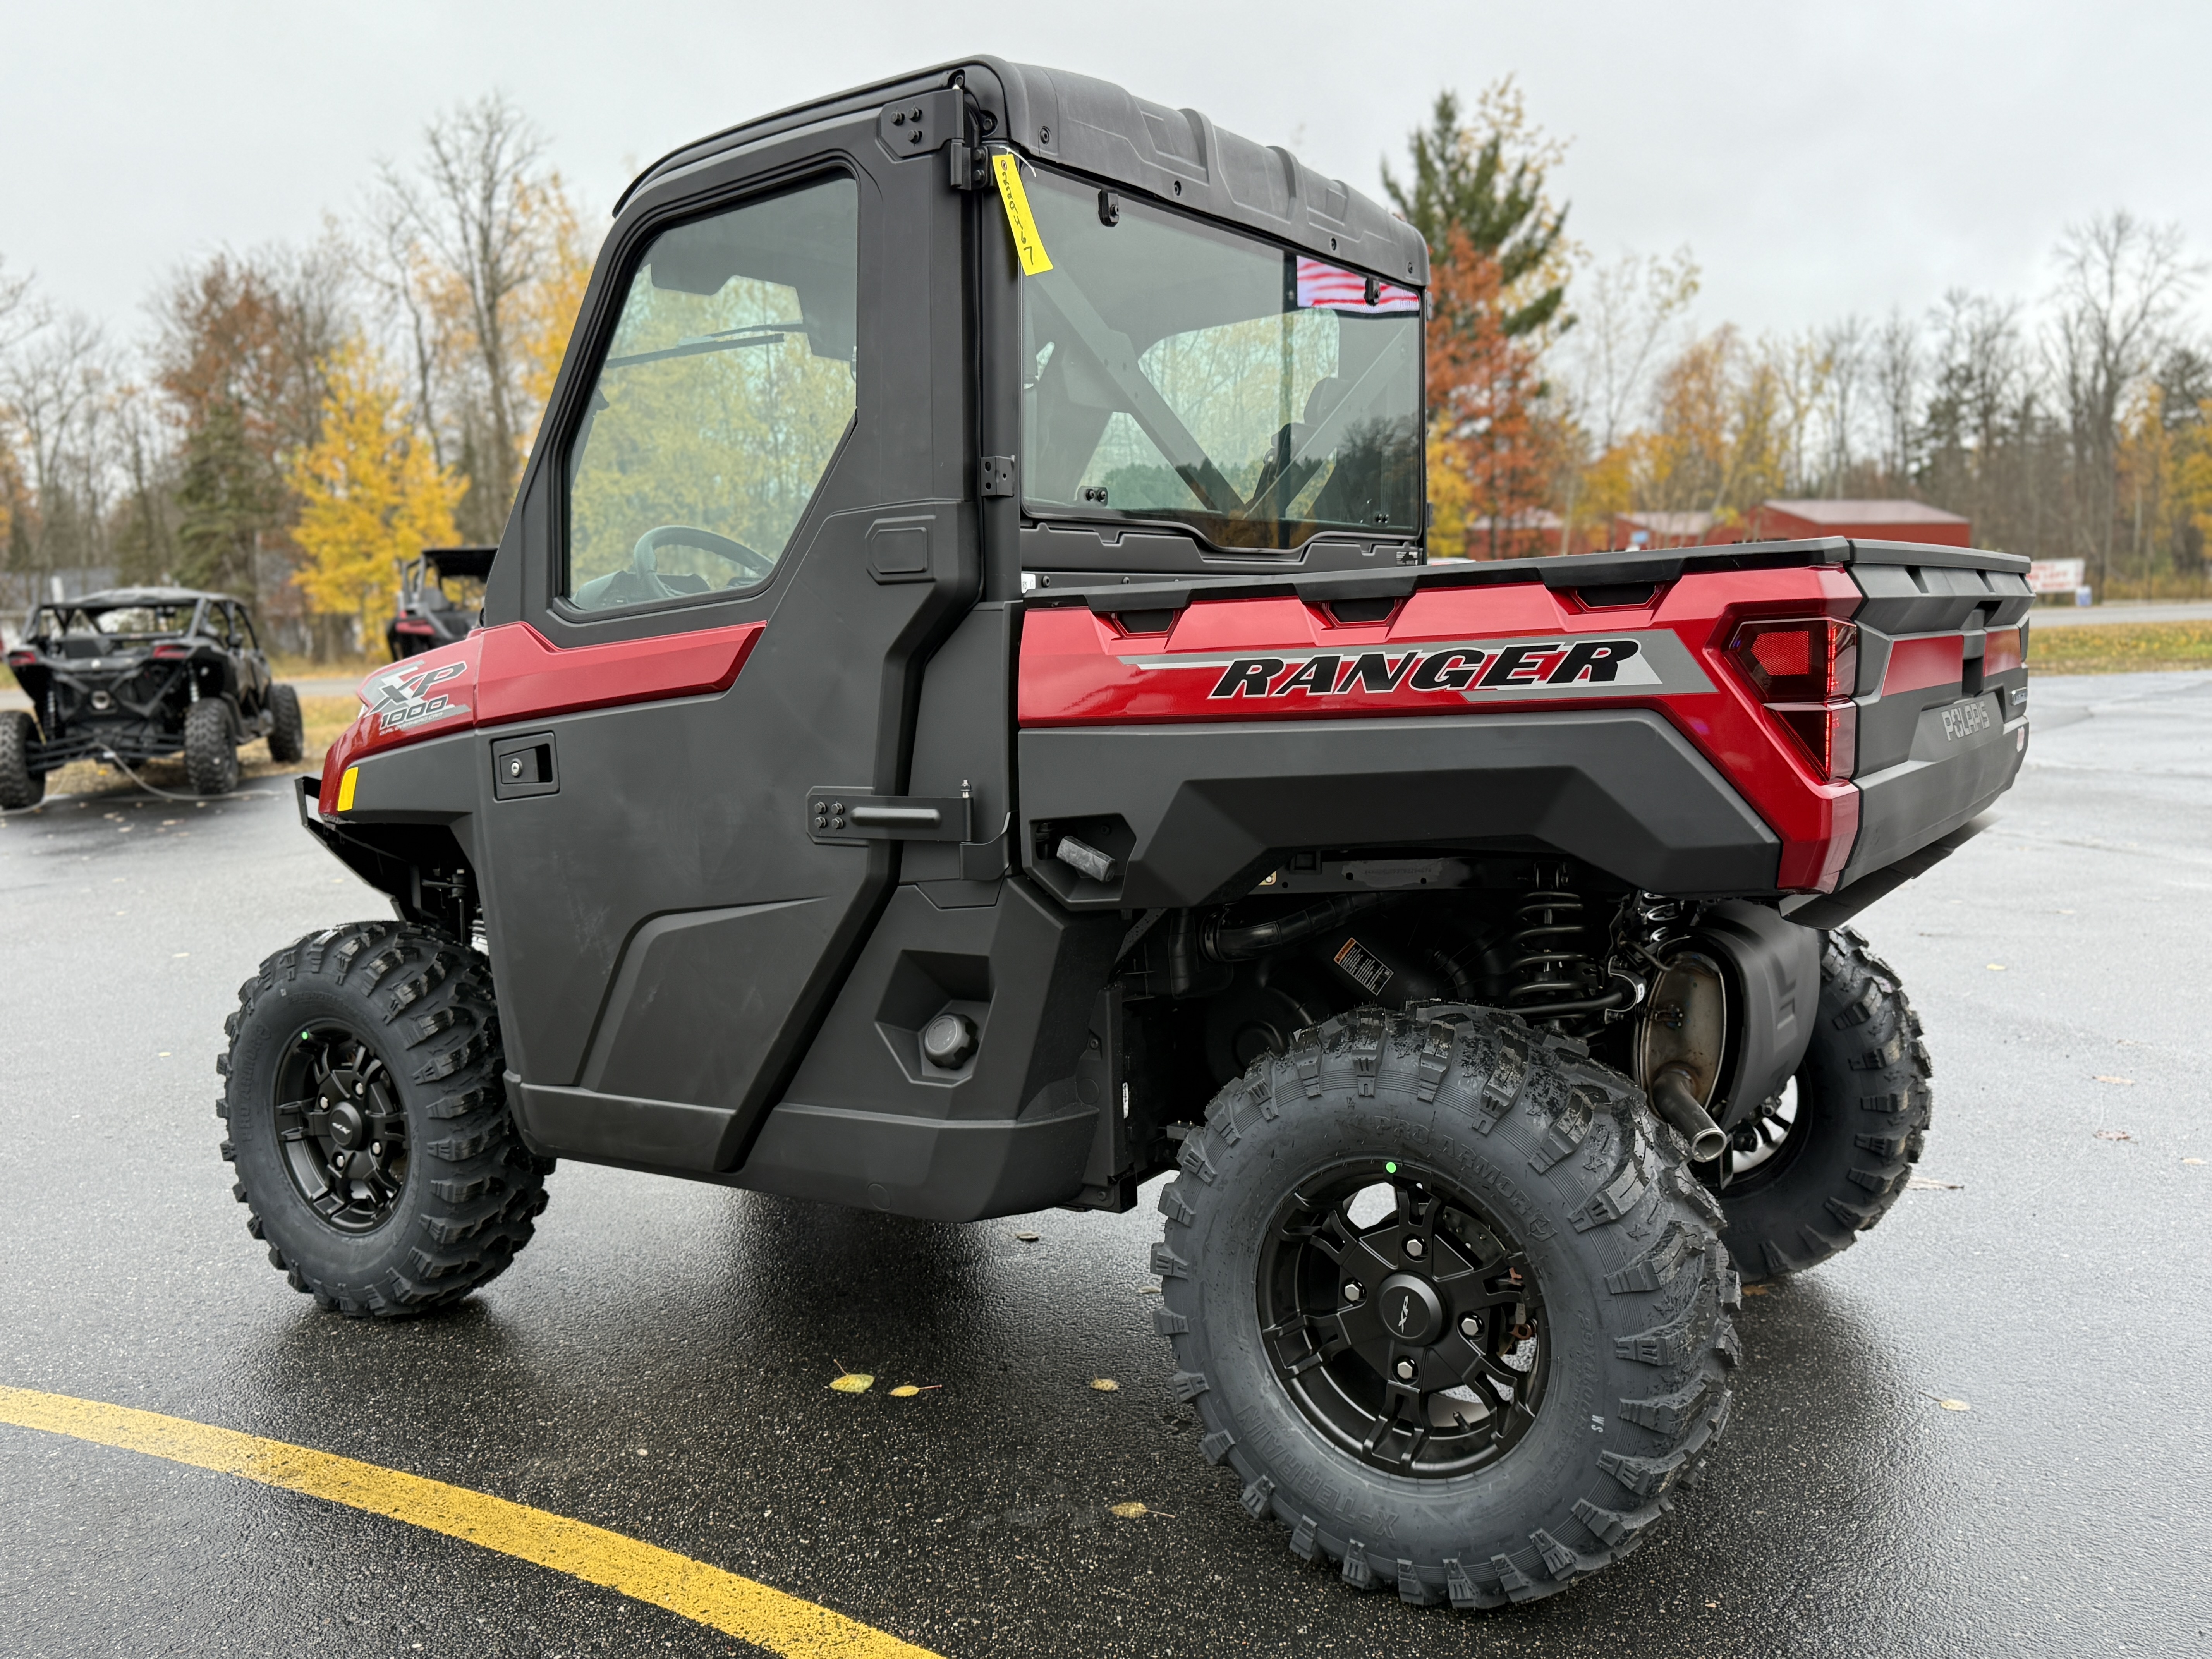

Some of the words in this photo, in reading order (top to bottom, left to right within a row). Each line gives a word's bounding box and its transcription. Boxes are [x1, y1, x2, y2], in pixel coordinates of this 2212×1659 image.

[364, 661, 467, 718] XP
[1207, 638, 1642, 699] RANGER
[380, 694, 448, 730] 1000
[1941, 701, 1990, 742] POLARIS
[1374, 1116, 1430, 1144] PRO
[1435, 1135, 1532, 1216] ARMOR
[1398, 1295, 1408, 1333] XP
[1236, 1404, 1399, 1539] X-TERRAIN
